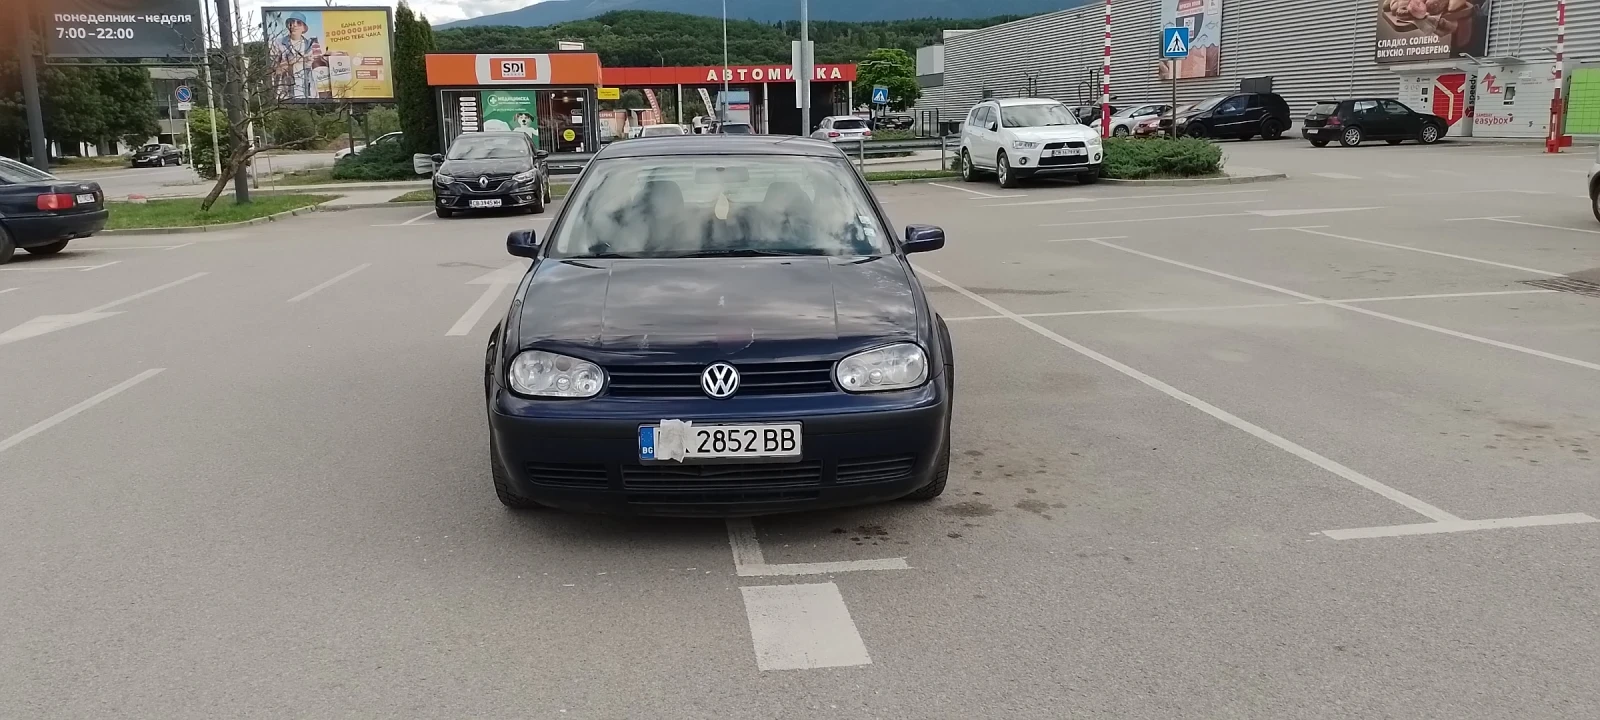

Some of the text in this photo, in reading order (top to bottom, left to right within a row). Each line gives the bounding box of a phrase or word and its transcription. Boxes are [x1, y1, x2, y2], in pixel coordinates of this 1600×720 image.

[1377, 35, 1440, 48] СЛАДКО. СОЛЕНО.
[1377, 44, 1451, 58] ВКУСНО. ПРОВЕРЕНО.
[503, 62, 524, 73] SDI
[706, 67, 842, 80] АВТОМИКА
[1469, 74, 1478, 104] speedy
[1474, 116, 1508, 126] easybox
[696, 429, 758, 453] 2852
[763, 428, 796, 452] BB
